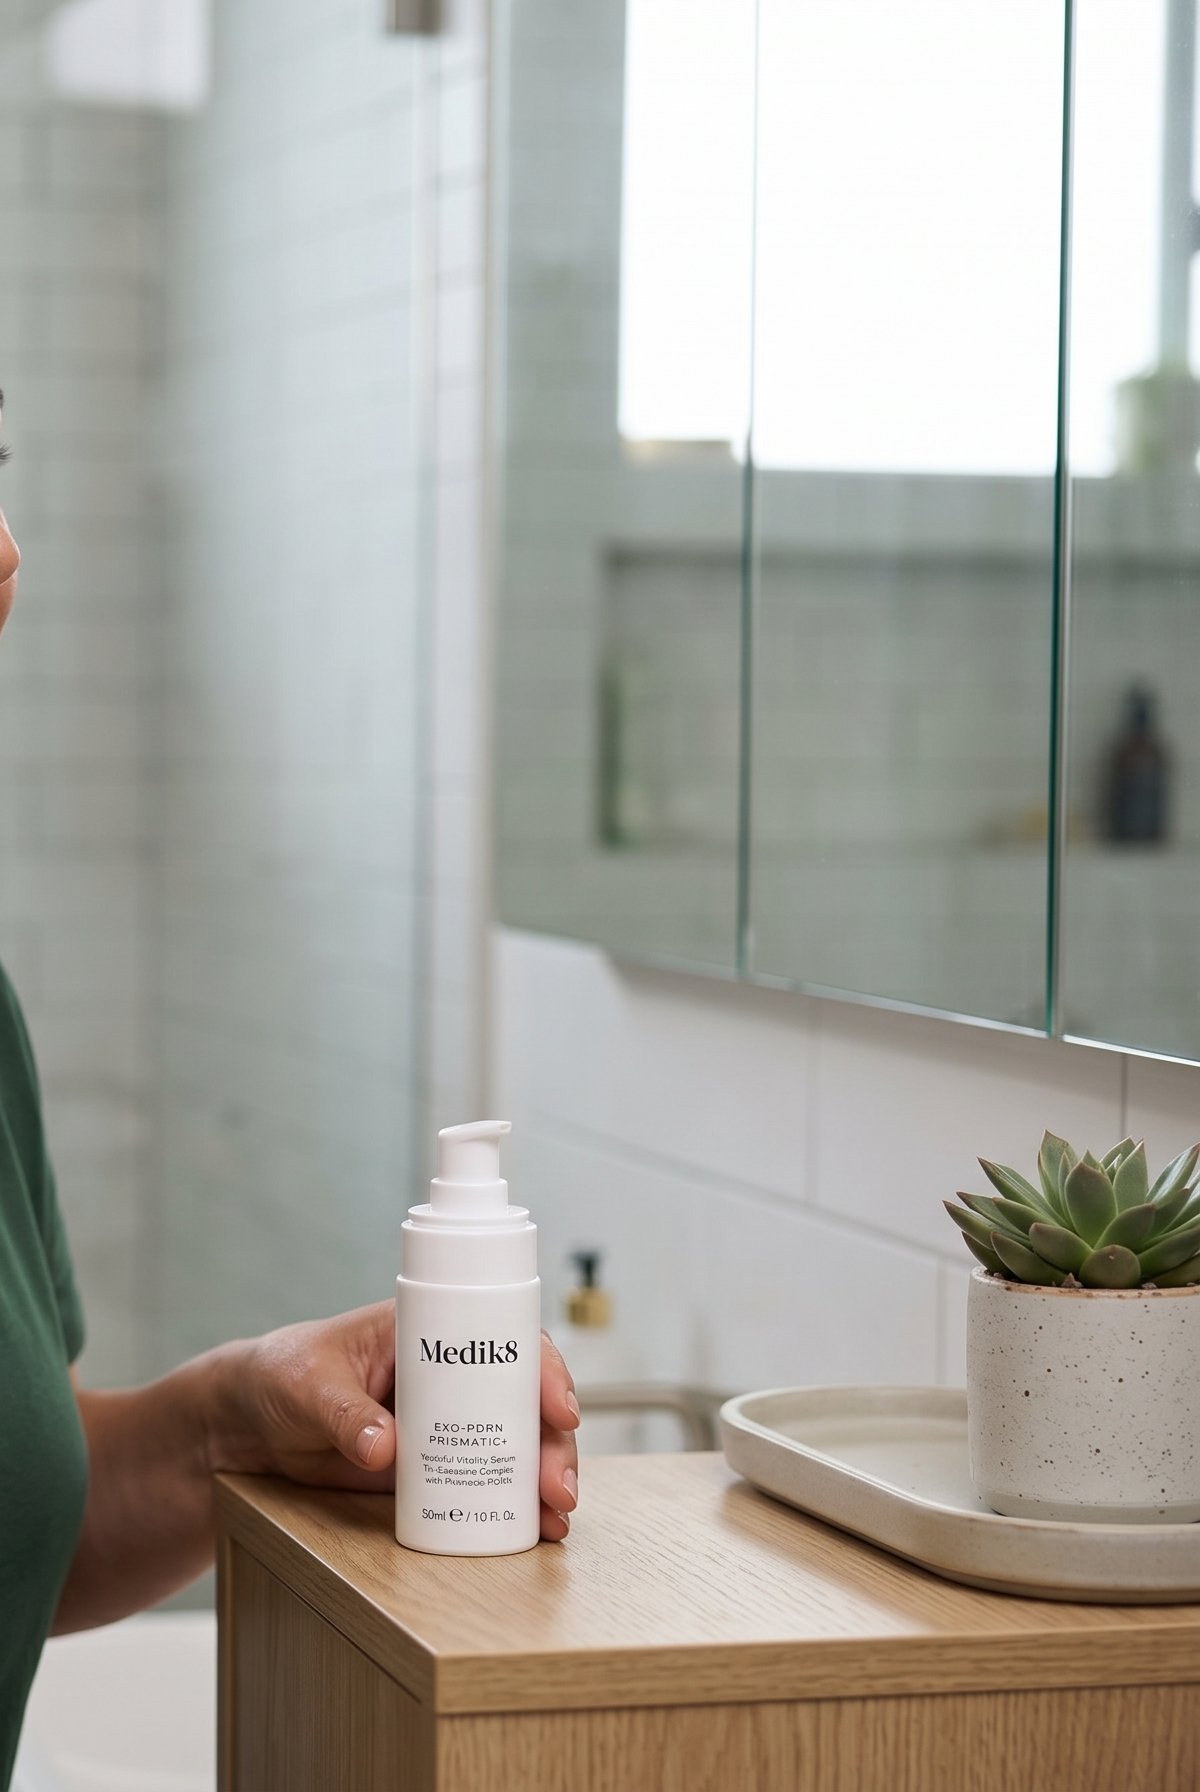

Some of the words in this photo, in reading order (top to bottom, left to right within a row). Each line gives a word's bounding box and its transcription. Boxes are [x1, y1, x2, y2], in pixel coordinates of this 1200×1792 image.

[419, 1337, 518, 1365] Medik8
[434, 1422, 503, 1433] EXO-PDRN
[429, 1435, 508, 1447] PRISMATIC+
[490, 1455, 516, 1464] Serum
[425, 1476, 443, 1485] with
